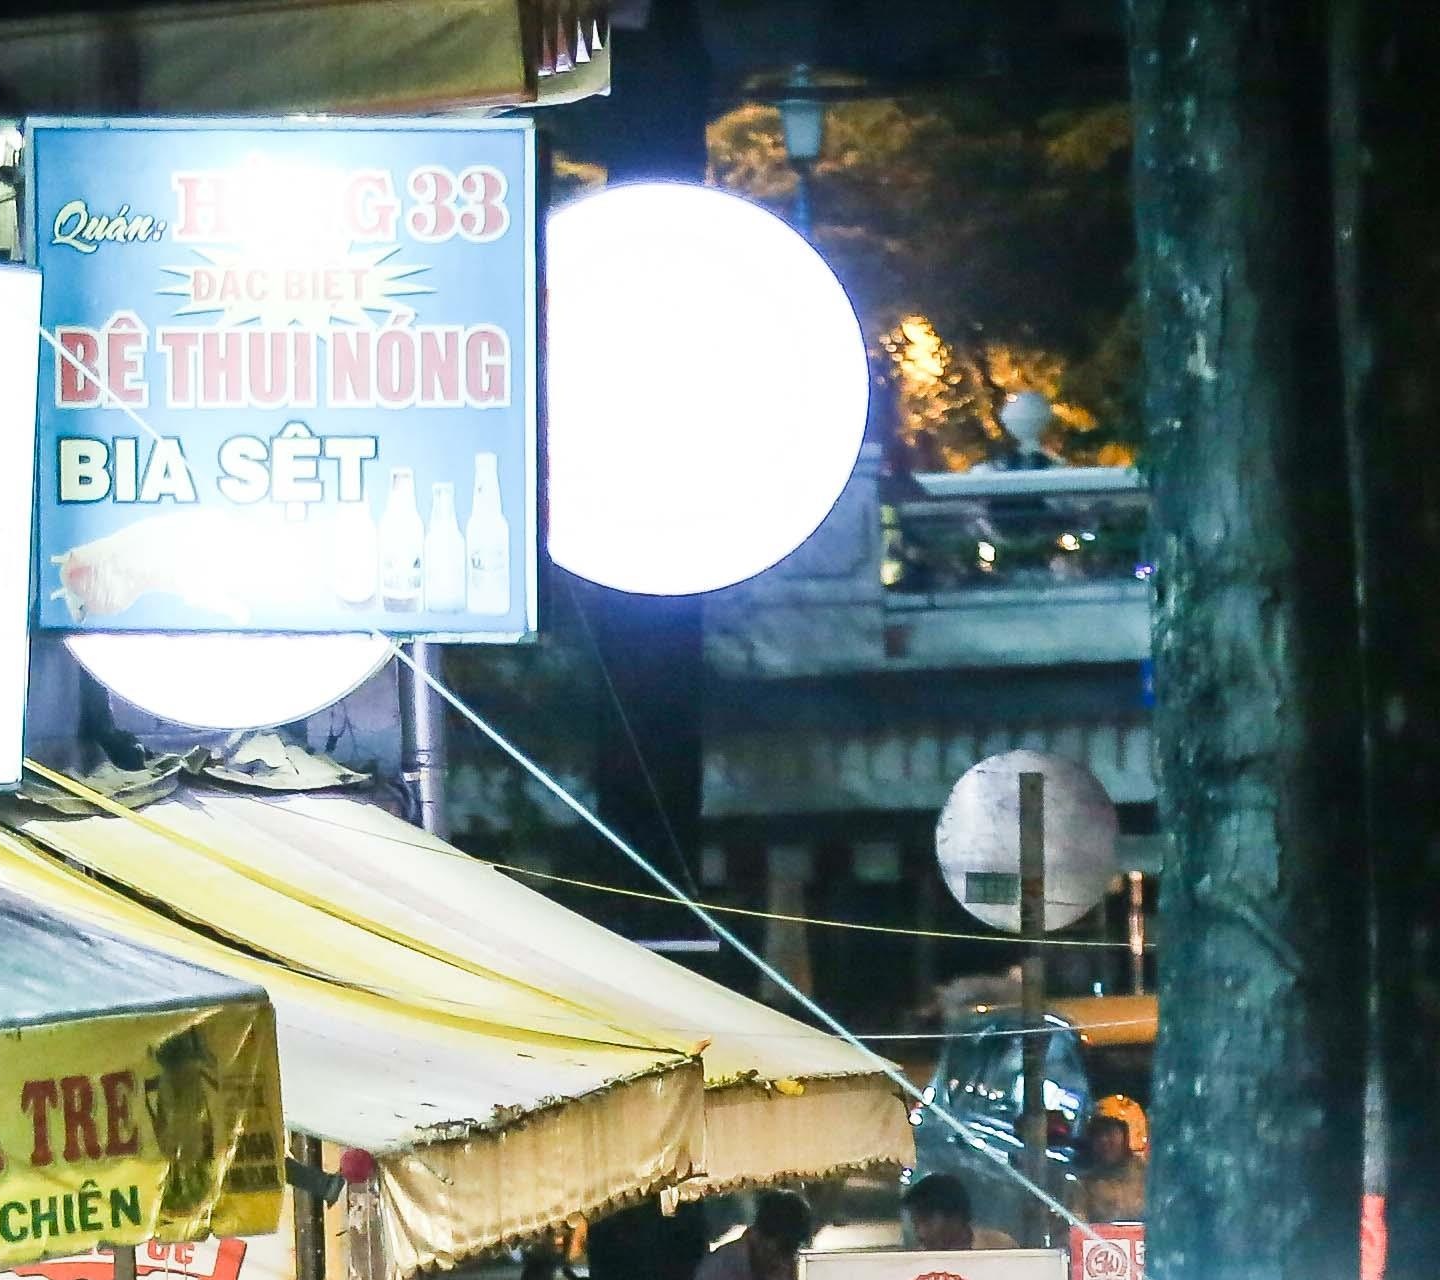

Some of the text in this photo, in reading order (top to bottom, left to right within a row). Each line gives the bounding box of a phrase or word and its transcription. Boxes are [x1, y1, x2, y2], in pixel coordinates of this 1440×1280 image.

[54, 170, 508, 253] Quán: HG 33
[60, 312, 507, 403] BÊ THUI NÓNG
[59, 420, 379, 522] BIA SỆT
[21, 1071, 140, 1167] TRE
